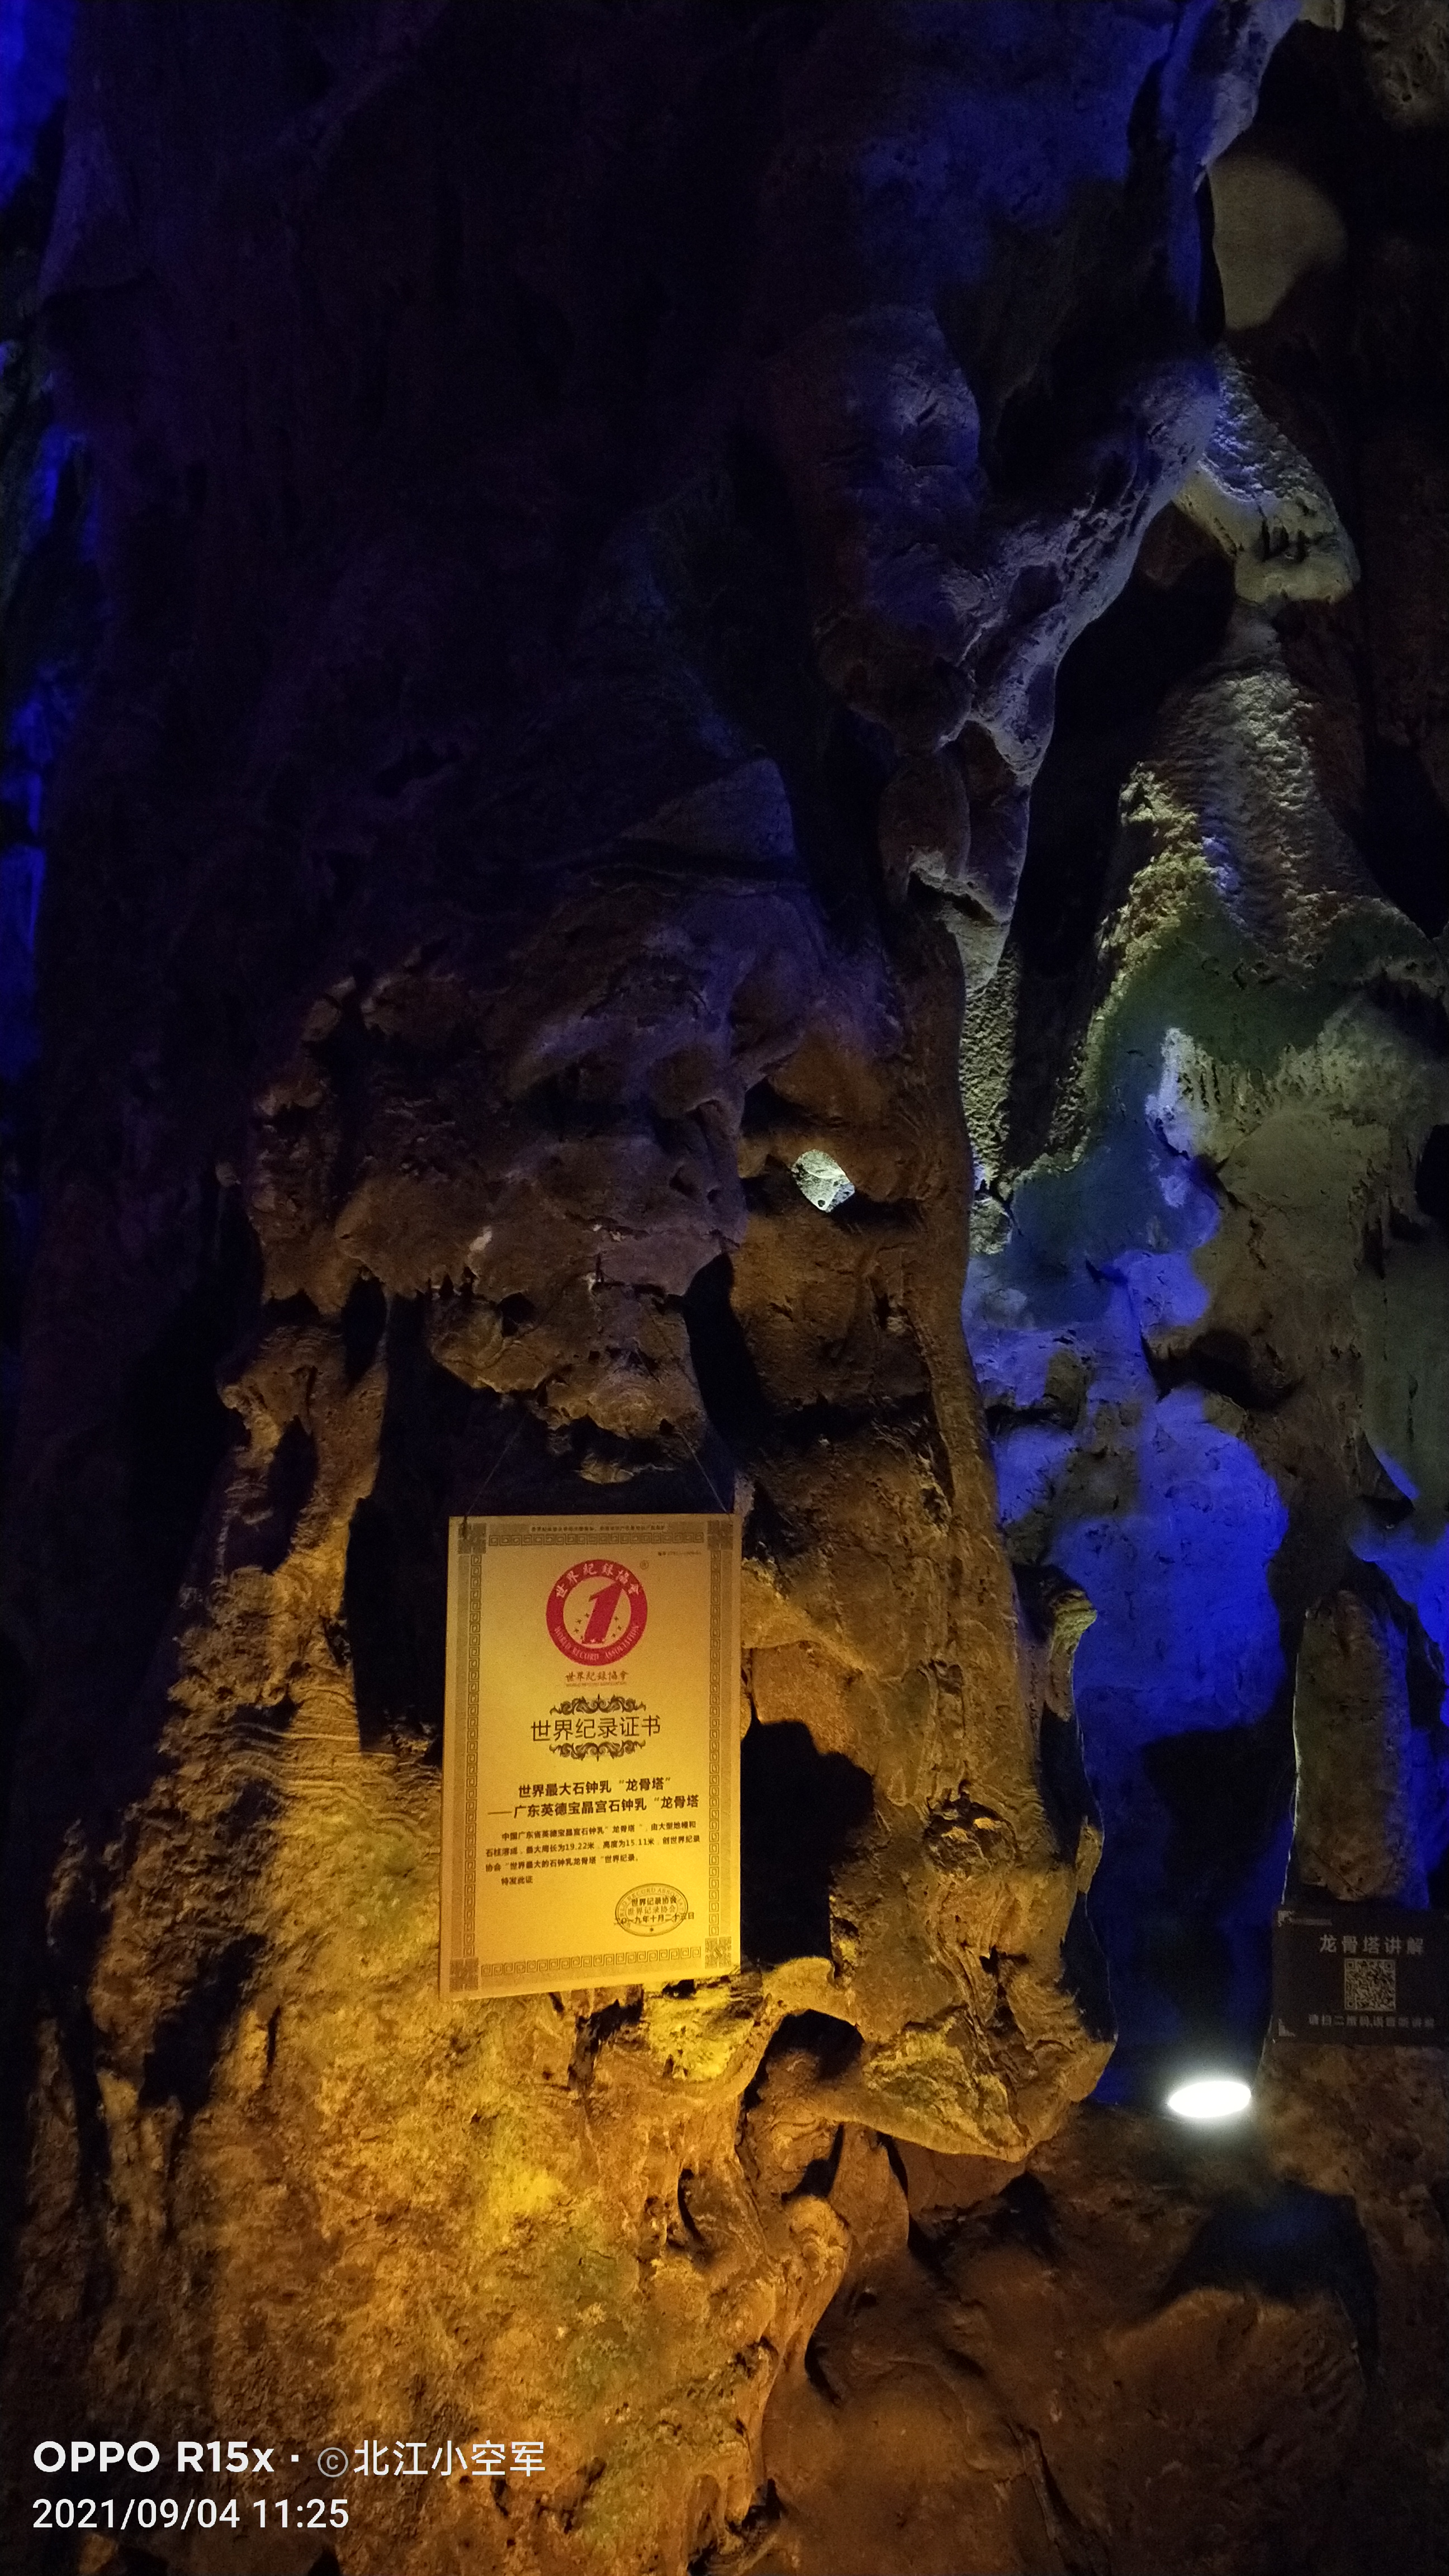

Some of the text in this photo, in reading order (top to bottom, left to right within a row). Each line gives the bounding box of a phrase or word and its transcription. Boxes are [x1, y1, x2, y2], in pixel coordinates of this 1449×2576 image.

[531, 1715, 661, 1742] 世界纪录证书
[501, 1875, 533, 1886] 特发此证
[1319, 1934, 1424, 1955] 龙骨塔讲解
